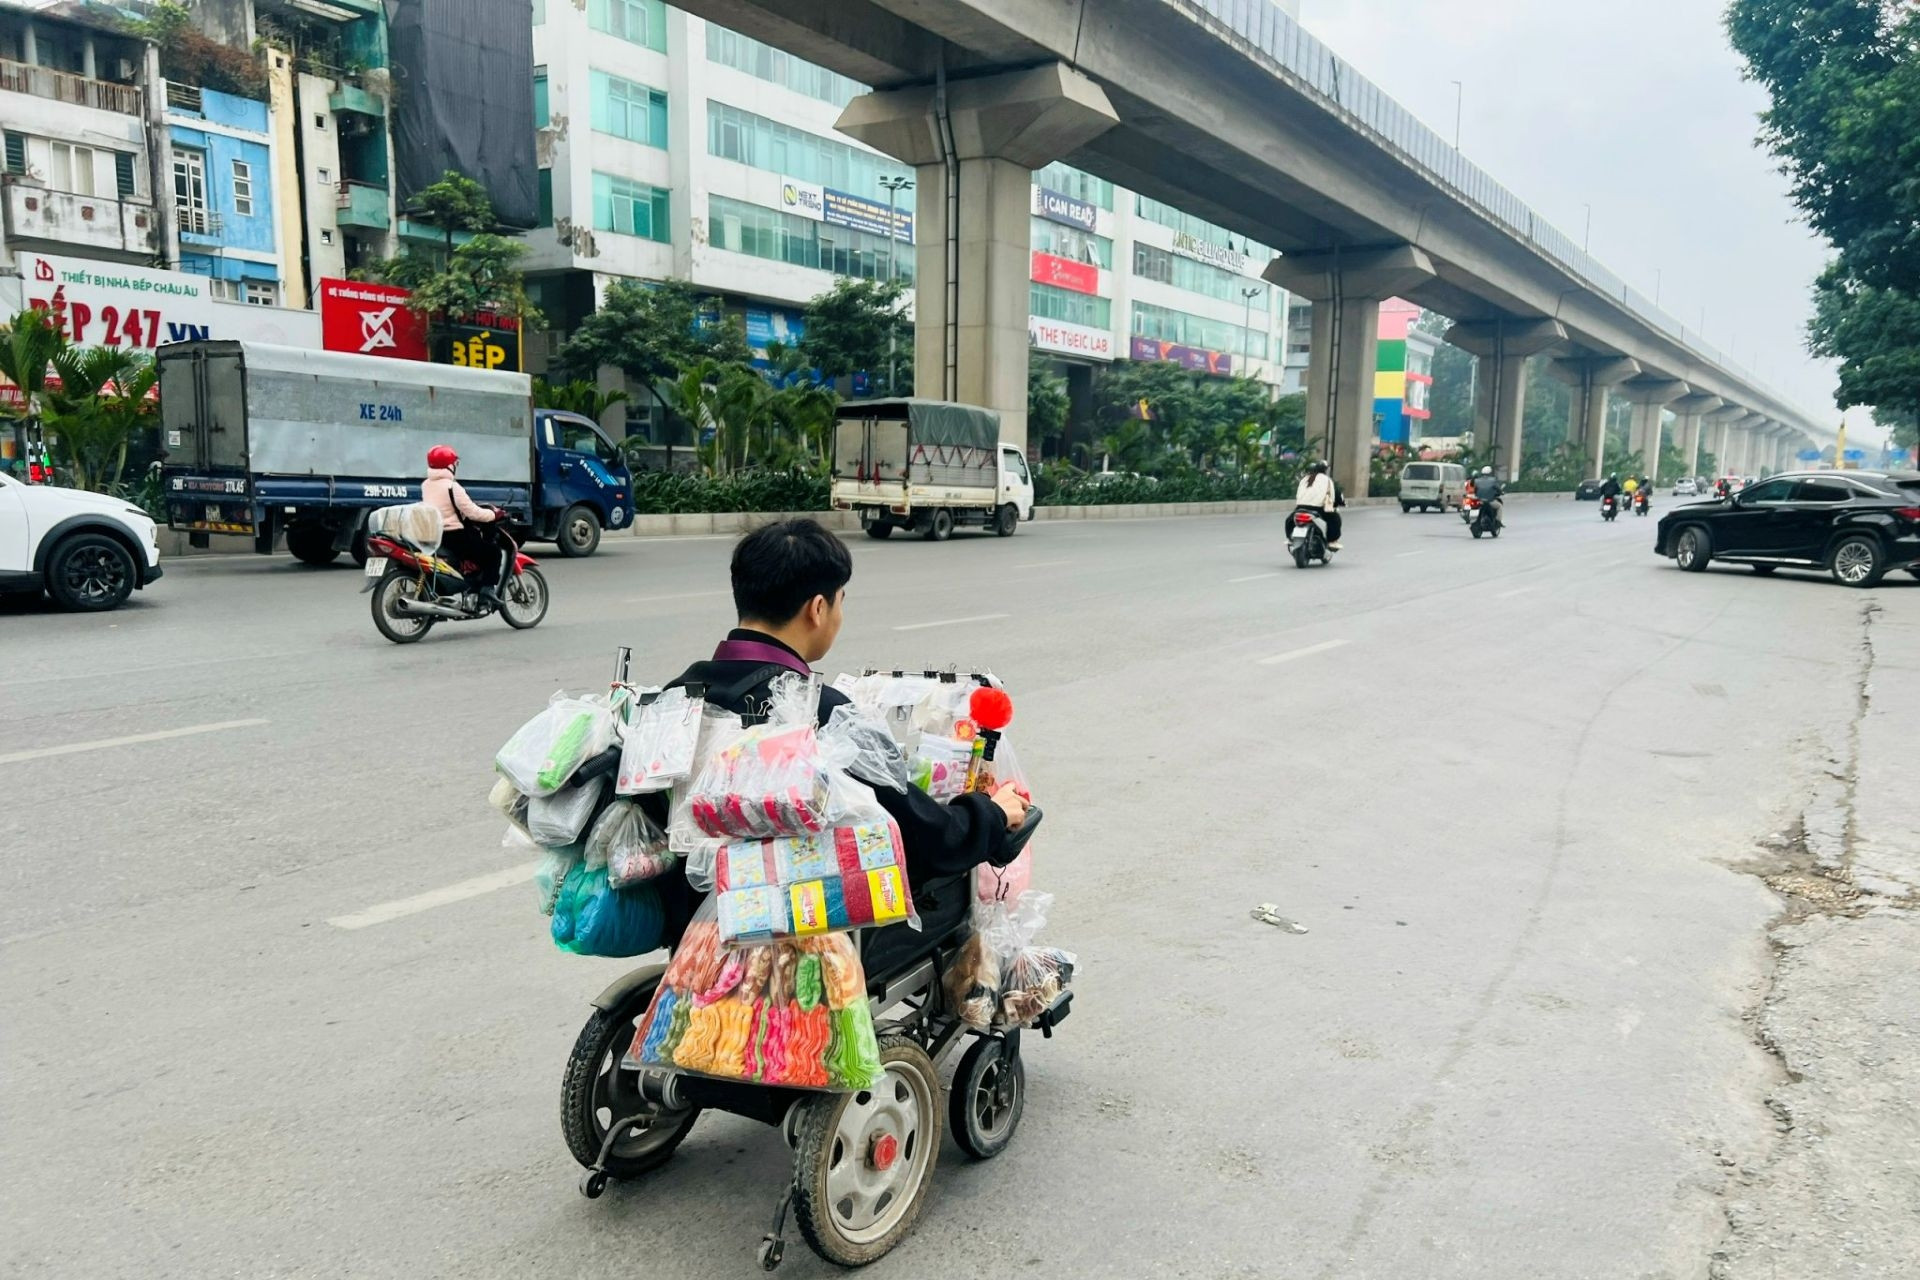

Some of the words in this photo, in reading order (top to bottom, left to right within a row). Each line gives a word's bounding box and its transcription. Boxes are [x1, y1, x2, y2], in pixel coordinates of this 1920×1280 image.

[799, 190, 817, 200] NEXT
[799, 198, 821, 211] TREND
[1049, 197, 1068, 216] CAN
[61, 270, 91, 285] THIẾT
[94, 275, 105, 288] BỊ
[106, 275, 130, 289] NHÀ
[132, 276, 152, 291] BẾP
[153, 282, 182, 295] CHÂU
[184, 285, 199, 297] ÂU
[101, 305, 161, 348] 247
[453, 331, 506, 369] BẾP
[1039, 326, 1058, 344] THE
[1061, 330, 1088, 349] TOEIC
[1090, 336, 1108, 353] LAB
[360, 403, 375, 420] XE
[379, 405, 402, 422] 24h
